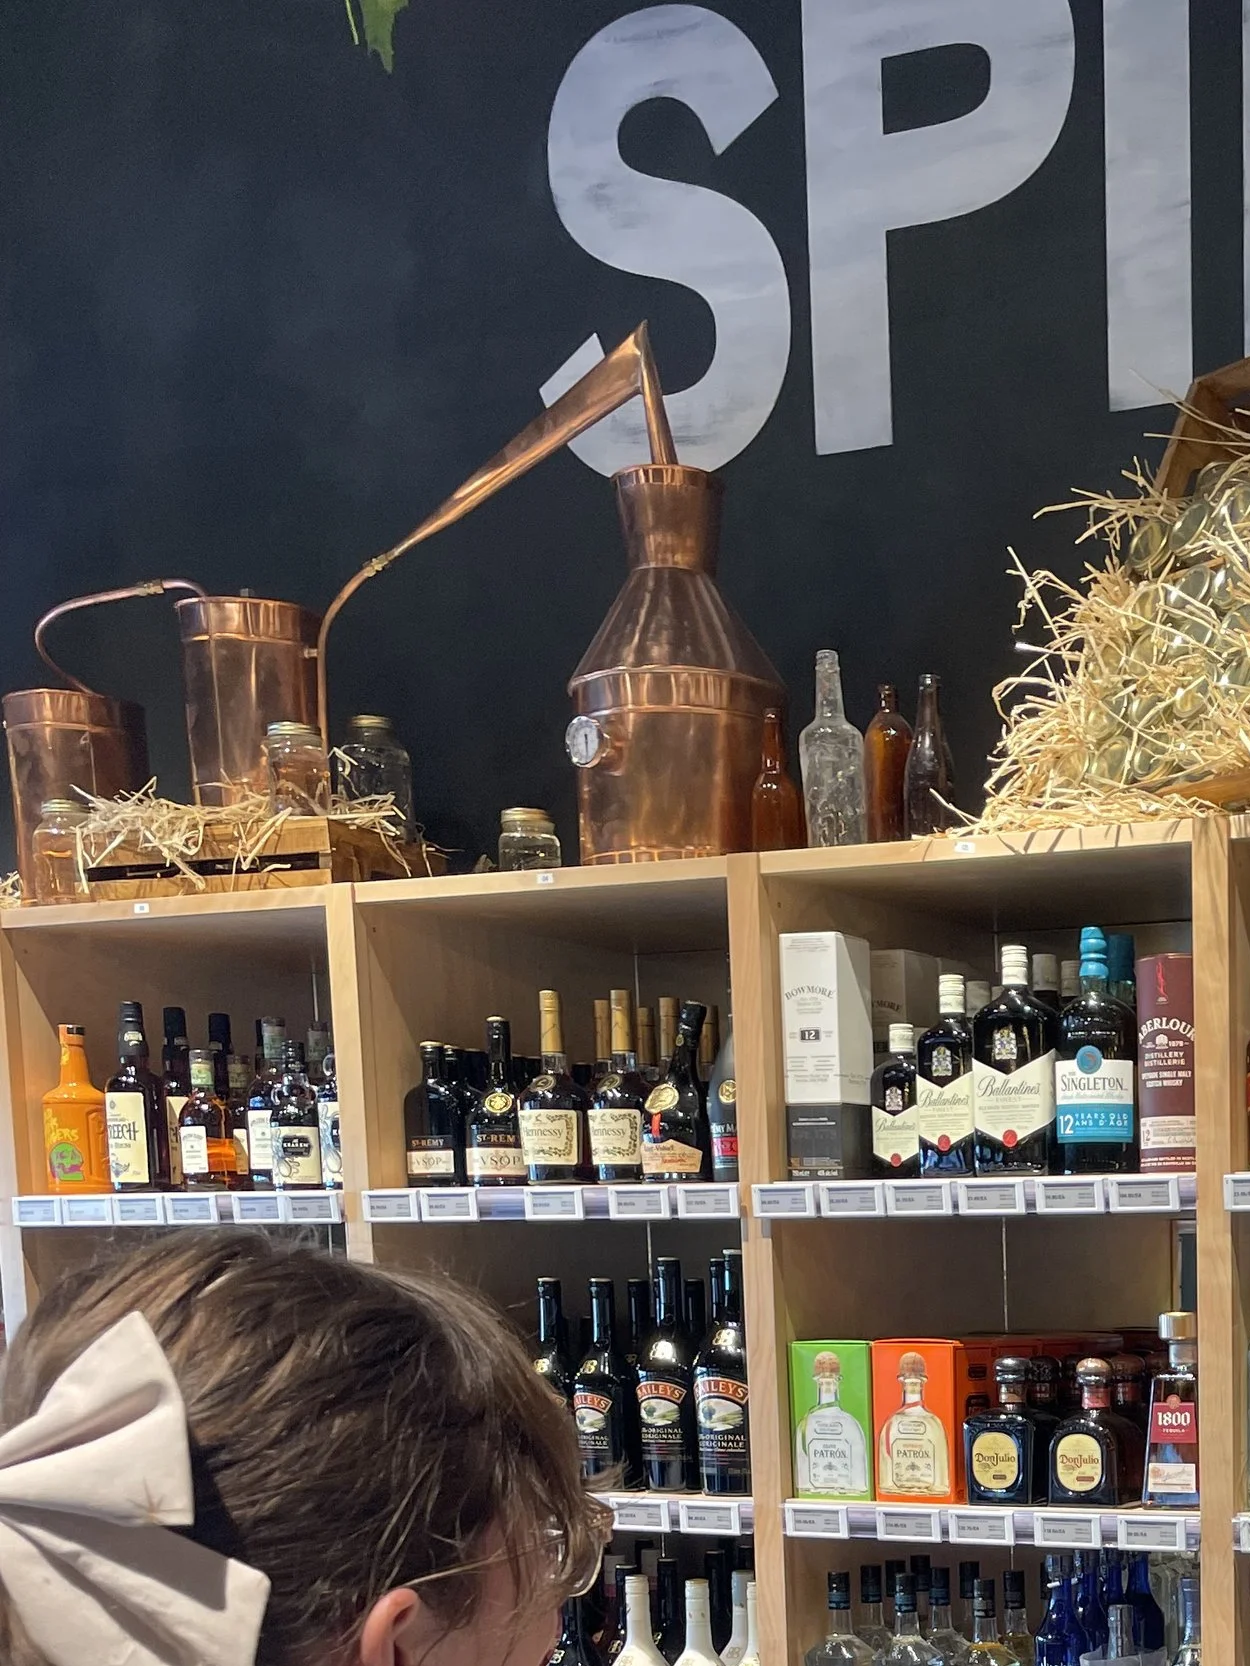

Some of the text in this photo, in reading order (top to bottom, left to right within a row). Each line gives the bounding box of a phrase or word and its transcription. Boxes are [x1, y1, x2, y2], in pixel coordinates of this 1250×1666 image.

[784, 985, 836, 1001] BOWMORE
[872, 999, 903, 1013] MORE
[803, 1030, 816, 1040] 12
[1139, 1017, 1195, 1043] ABERLOUR
[1144, 1051, 1184, 1059] DISTILLERY
[977, 1075, 1041, 1098] Ballantine's
[1060, 1075, 1123, 1092] SINGLETON
[919, 1088, 969, 1107] Ballantine's
[523, 1126, 563, 1139] Hennessy
[1059, 1115, 1074, 1135] 12
[637, 1384, 683, 1400] BAILEYS
[574, 1395, 608, 1410] AILEYS
[1157, 1411, 1191, 1427] 1800
[813, 1448, 847, 1459] PATRÓN
[896, 1448, 931, 1459] PATRÓN
